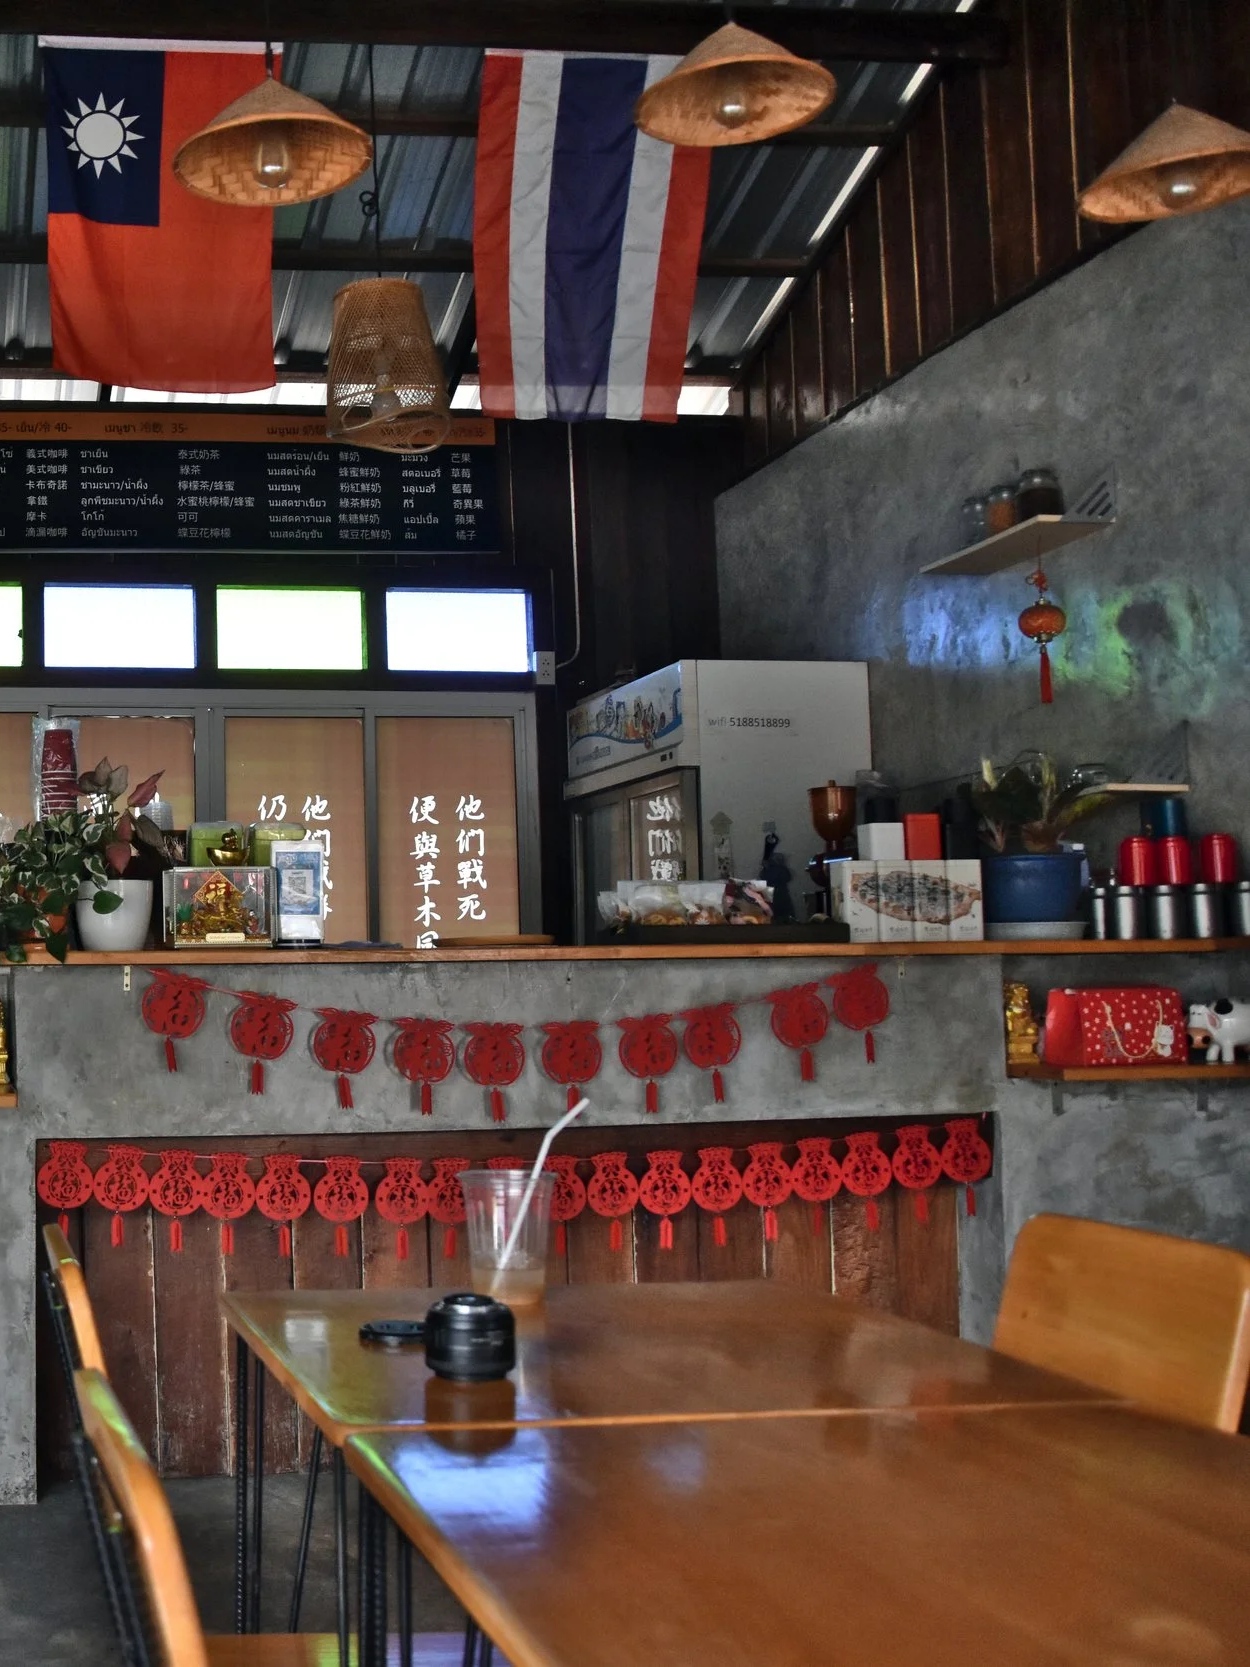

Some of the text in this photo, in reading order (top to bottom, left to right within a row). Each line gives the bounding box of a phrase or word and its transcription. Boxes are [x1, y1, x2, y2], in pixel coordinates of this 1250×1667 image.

[730, 717, 791, 728] 5188518899
[455, 795, 487, 921] 他們戰死
